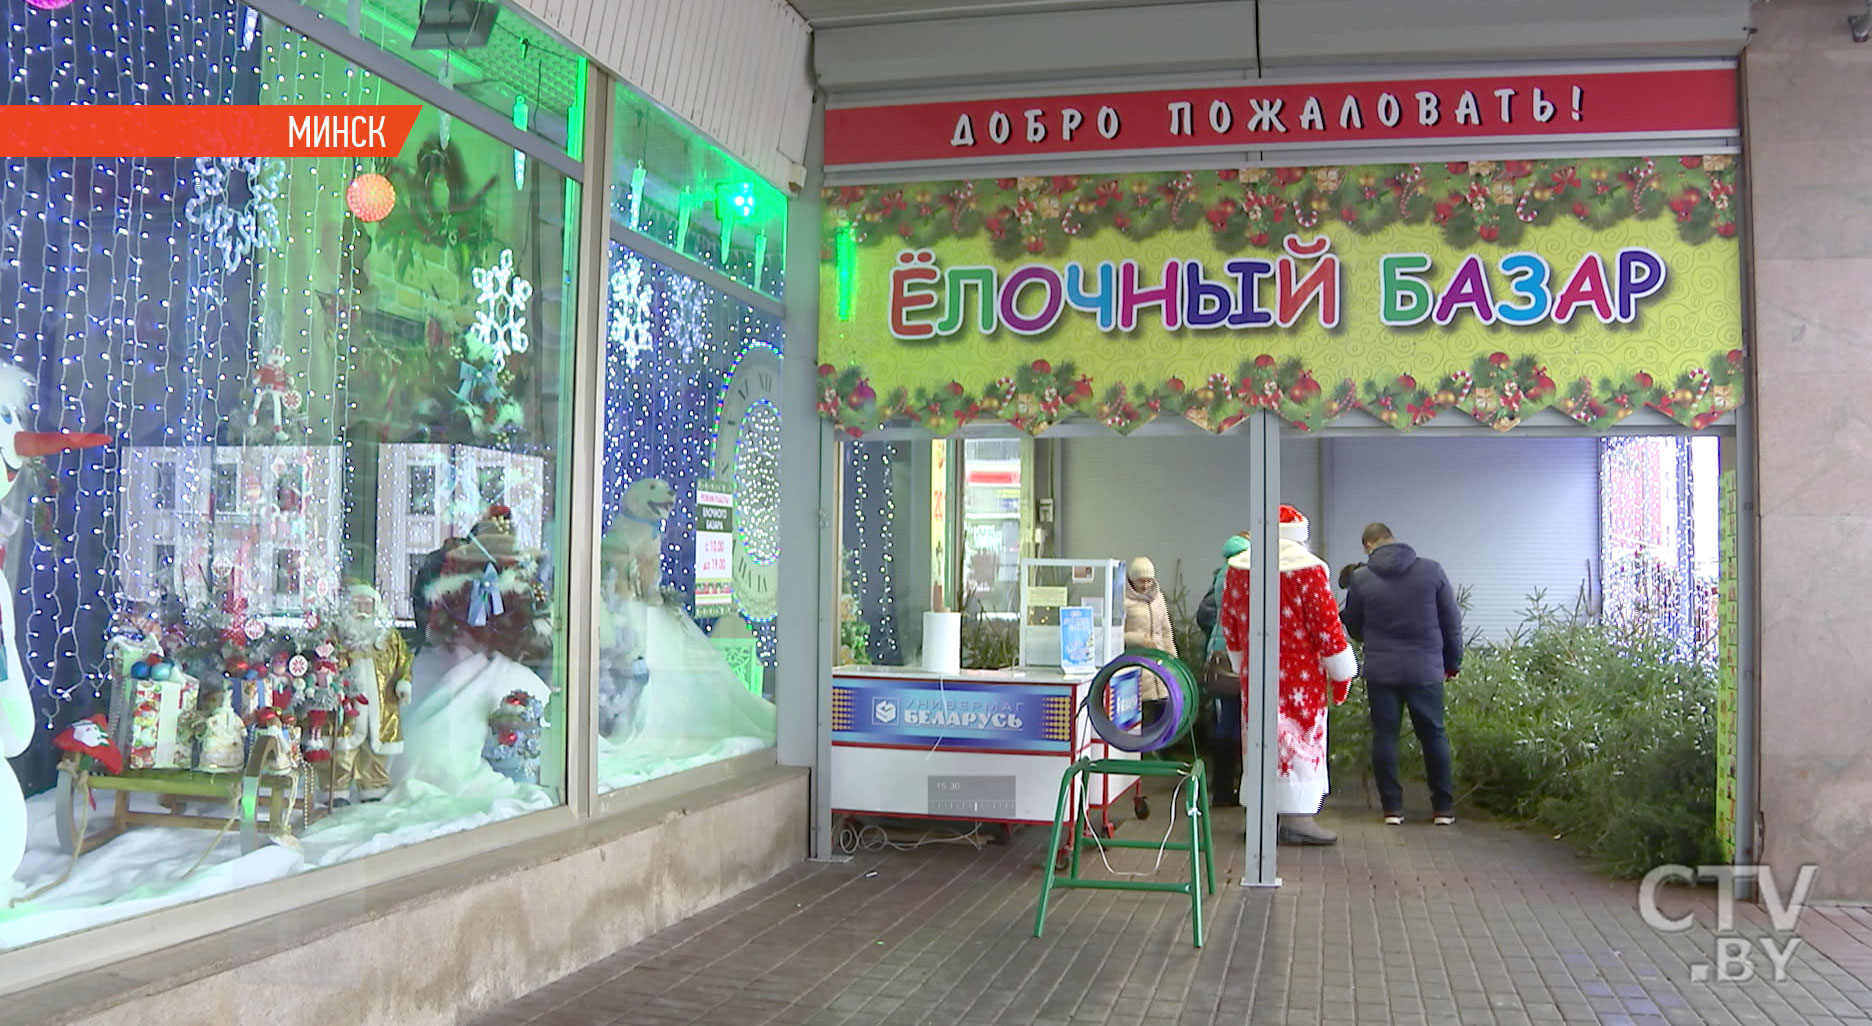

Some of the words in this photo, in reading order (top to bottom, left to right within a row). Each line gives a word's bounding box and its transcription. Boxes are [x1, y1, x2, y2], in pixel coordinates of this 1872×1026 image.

[951, 105, 1120, 146] ДОБРО
[1168, 85, 1583, 136] ПОЖАЛОВАТЬ!
[889, 234, 1341, 338] ЁЛОЧНЫЙ
[1380, 247, 1667, 326] БАЗАР
[904, 698, 1025, 712] УНИВЕРМАГ
[904, 709, 1023, 729] БЕЛАРУСЬ
